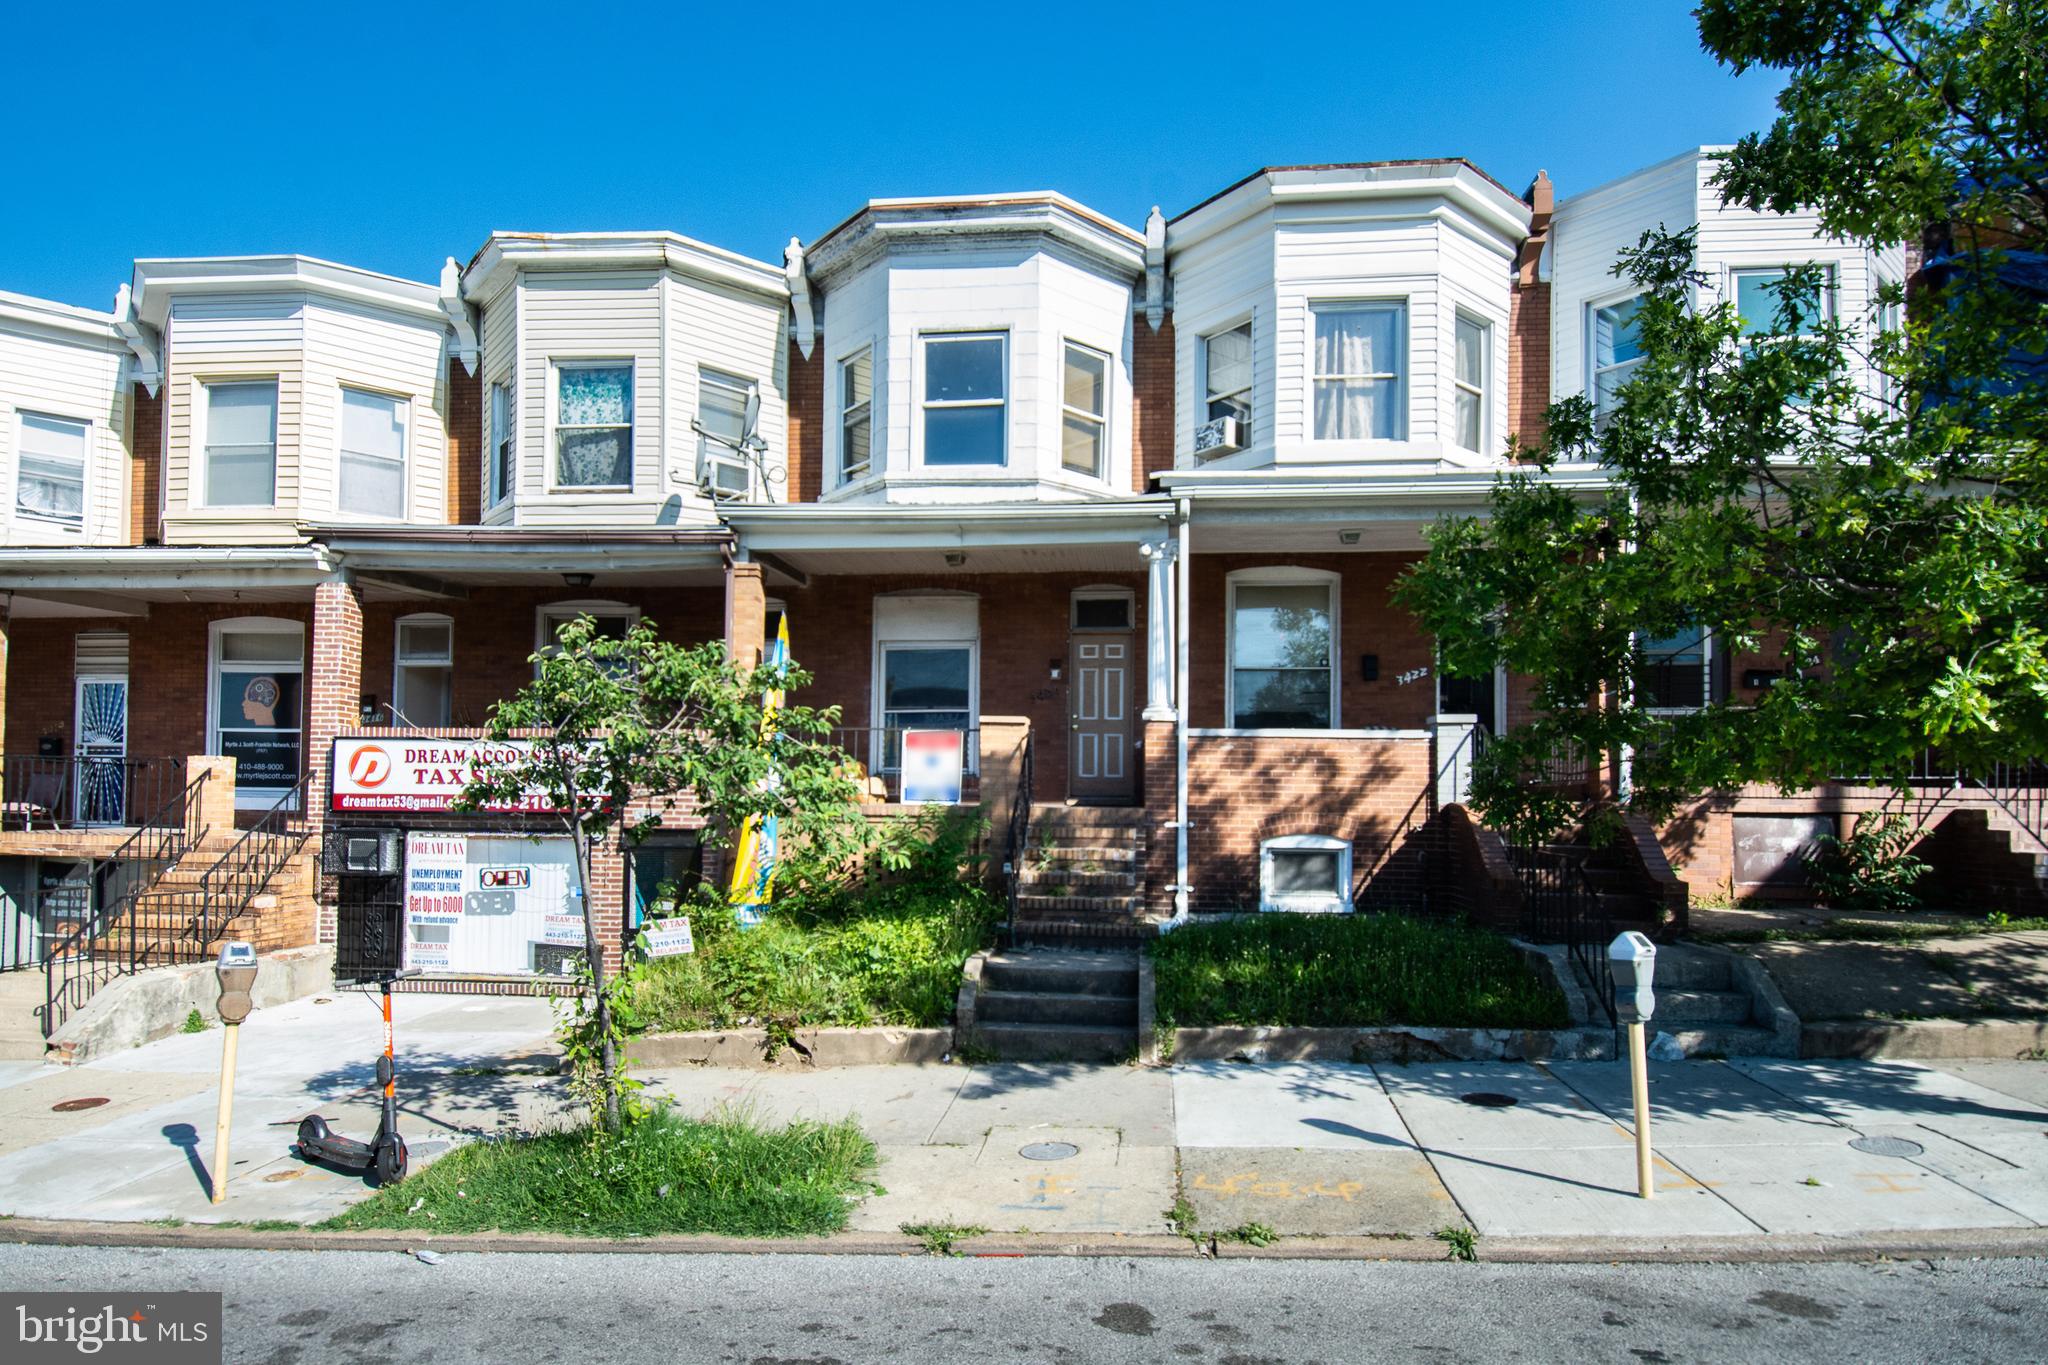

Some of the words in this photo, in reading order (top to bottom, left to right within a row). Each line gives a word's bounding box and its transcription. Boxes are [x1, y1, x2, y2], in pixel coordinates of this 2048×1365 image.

[1396, 667, 1428, 686] 3422
[404, 749, 466, 764] DREAM
[236, 772, 297, 780] w.myrtlejscott.com
[413, 769, 465, 785] TAX
[342, 795, 471, 810] dreamtax53@gmail.c
[411, 841, 443, 855] DREAM
[446, 842, 464, 855] TAX
[411, 868, 463, 879] UNEMPLOYMENT
[482, 870, 528, 887] OPEN
[411, 882, 436, 892] INSURANCE
[437, 882, 445, 892] TAX
[446, 882, 460, 892] FILING
[409, 895, 422, 912] Get
[423, 896, 432, 914] Up
[433, 896, 441, 912] to
[443, 896, 463, 913] 6000
[669, 919, 687, 928] TAX
